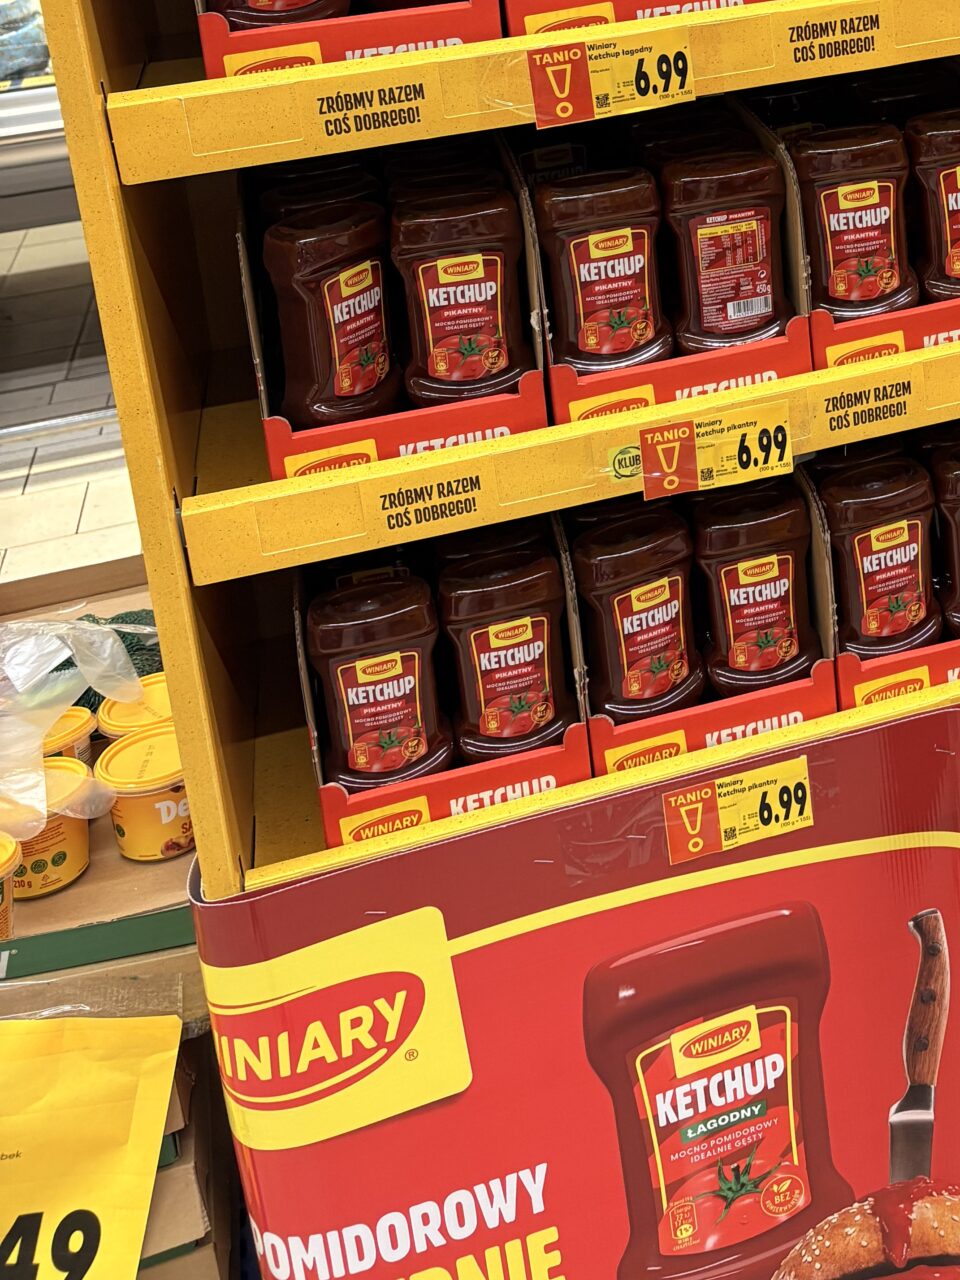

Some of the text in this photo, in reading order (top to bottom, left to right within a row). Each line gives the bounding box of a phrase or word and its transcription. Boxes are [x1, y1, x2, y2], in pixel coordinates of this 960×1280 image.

[533, 48, 581, 65] TANIO
[587, 41, 617, 52] Winiary
[588, 44, 653, 63] Ketchup łagodny
[634, 50, 689, 96] 6.99
[317, 90, 373, 115] ZRÓBMY
[324, 114, 352, 137] COŚ
[829, 206, 890, 231] KETCHUP
[579, 255, 645, 282] KETCHUP
[428, 282, 497, 307] KETCHUP
[444, 307, 483, 317] PIKANTNY
[824, 391, 871, 414] ZRÓBMY
[695, 418, 722, 430] Winiary
[696, 419, 758, 439] Ketchup pikantny
[829, 410, 850, 432] COŚ
[644, 426, 690, 445] TANIO
[737, 425, 788, 470] 6.99
[729, 578, 789, 607] KETCHUP
[347, 675, 415, 705] KETCHUP
[363, 701, 403, 714] PIKANTNY
[716, 778, 744, 790] Winiary
[718, 778, 778, 798] Ketchup pikantny
[668, 788, 712, 807] TANIO
[759, 782, 807, 826] 6.99
[360, 813, 419, 840] WINIARY
[215, 990, 408, 1081] INIARY
[690, 1023, 748, 1057] WINIARY
[654, 1053, 785, 1127] KETCHUP
[686, 1104, 762, 1138] ŁAGODNY
[670, 1118, 779, 1161] MOCNO POMIDOROWY
[690, 1132, 764, 1163] IDEALNIE GĘSTY
[774, 1192, 791, 1204] BEZ
